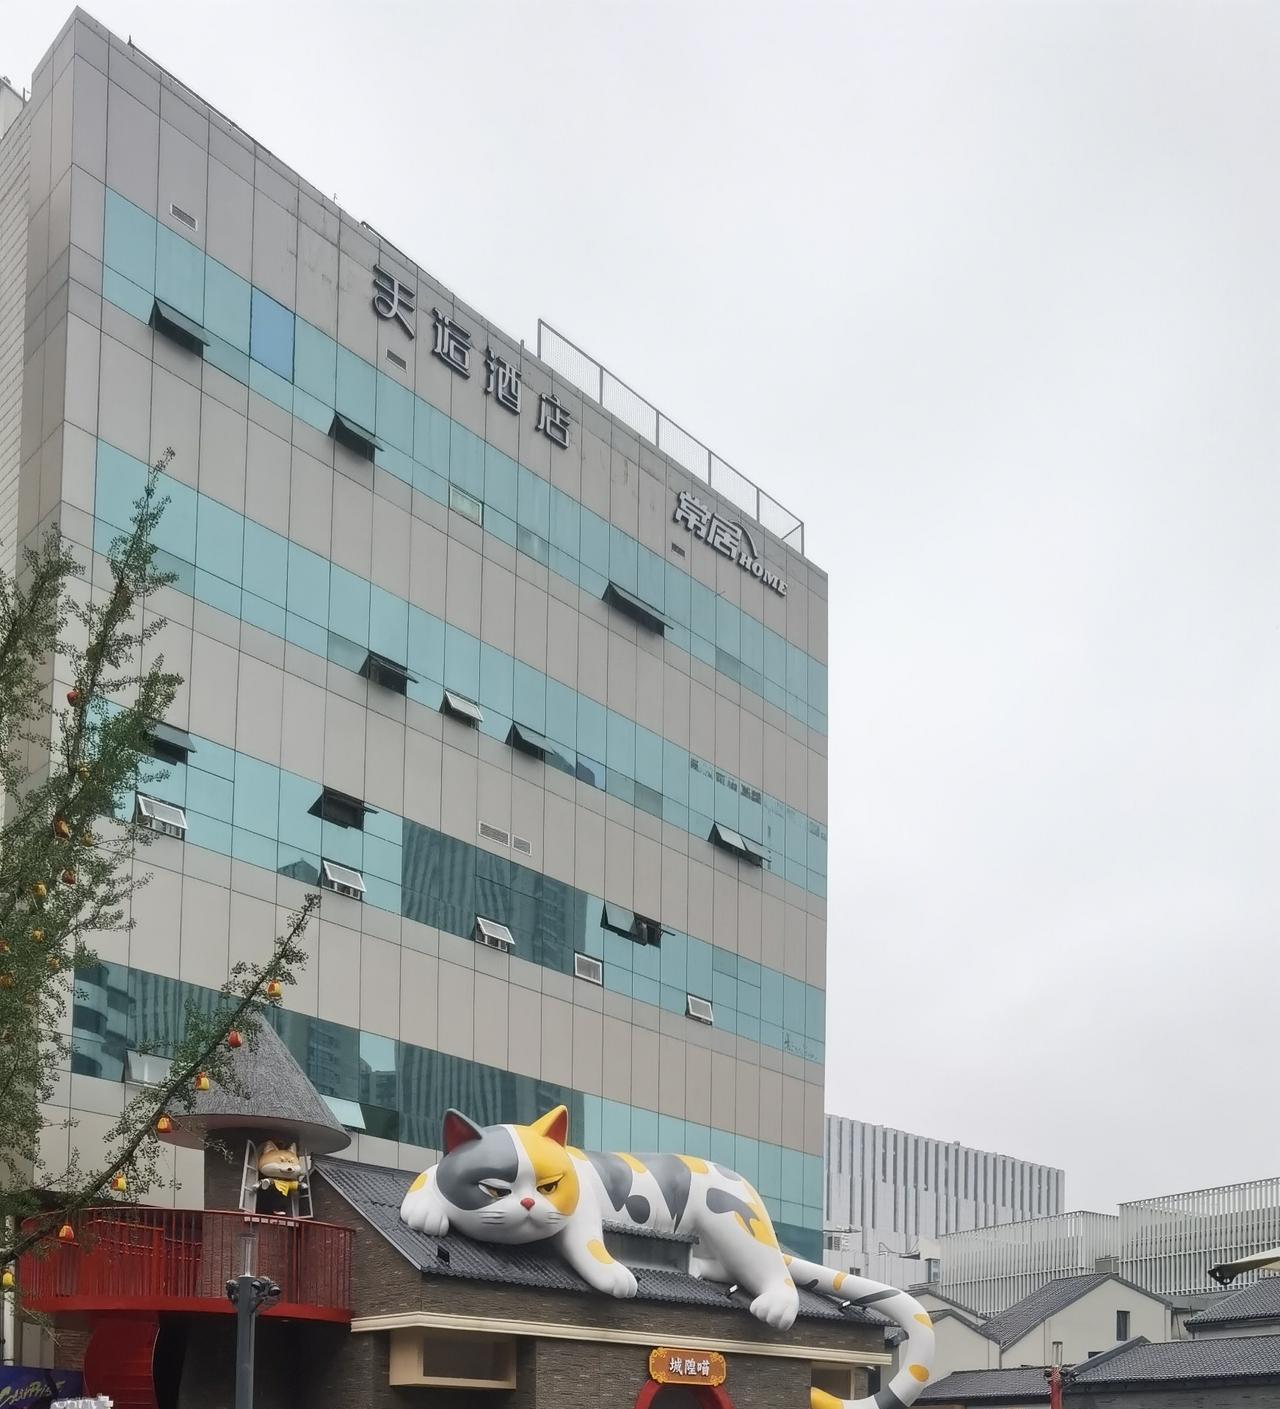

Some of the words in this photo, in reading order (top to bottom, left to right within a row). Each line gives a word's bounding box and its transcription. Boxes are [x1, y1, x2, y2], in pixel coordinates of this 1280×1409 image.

[373, 263, 570, 449] 天逅酒店
[673, 491, 742, 560] 常居
[737, 552, 788, 597] HOME
[669, 1357, 710, 1377] 城隍喵
